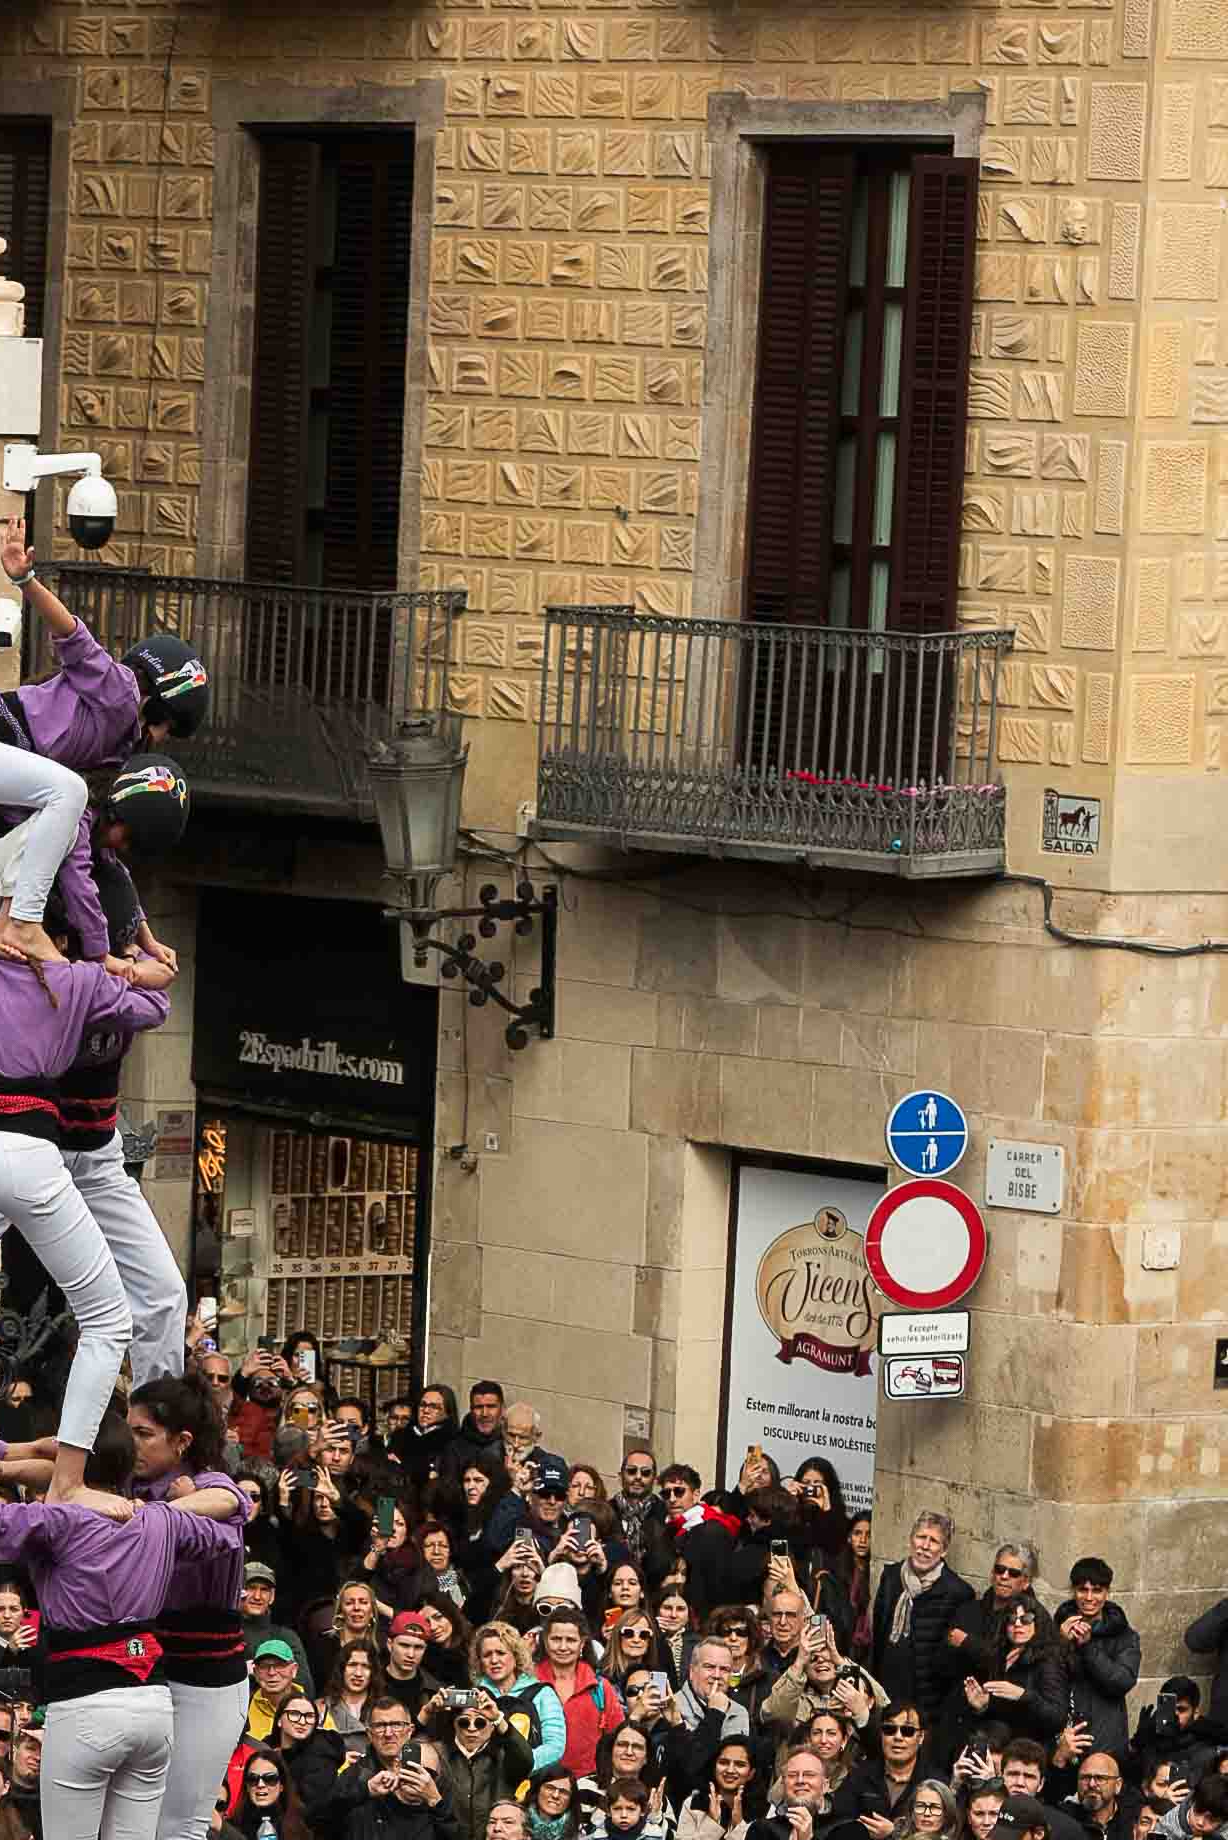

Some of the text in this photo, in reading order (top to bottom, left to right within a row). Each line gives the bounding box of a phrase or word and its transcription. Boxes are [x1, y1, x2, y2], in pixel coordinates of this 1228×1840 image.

[1043, 839, 1094, 854] SALIDA
[1006, 1151, 1043, 1165] CARRER
[1014, 1167, 1033, 1179] DEL
[1007, 1181, 1038, 1200] BISBE
[796, 1341, 853, 1368] AGRAMUNT
[746, 1397, 775, 1413] Estem
[778, 1403, 820, 1421] millorant
[822, 1408, 831, 1422] la
[832, 1414, 863, 1427] nostra
[763, 1426, 810, 1443] DISCULPEU
[812, 1434, 827, 1446] LES
